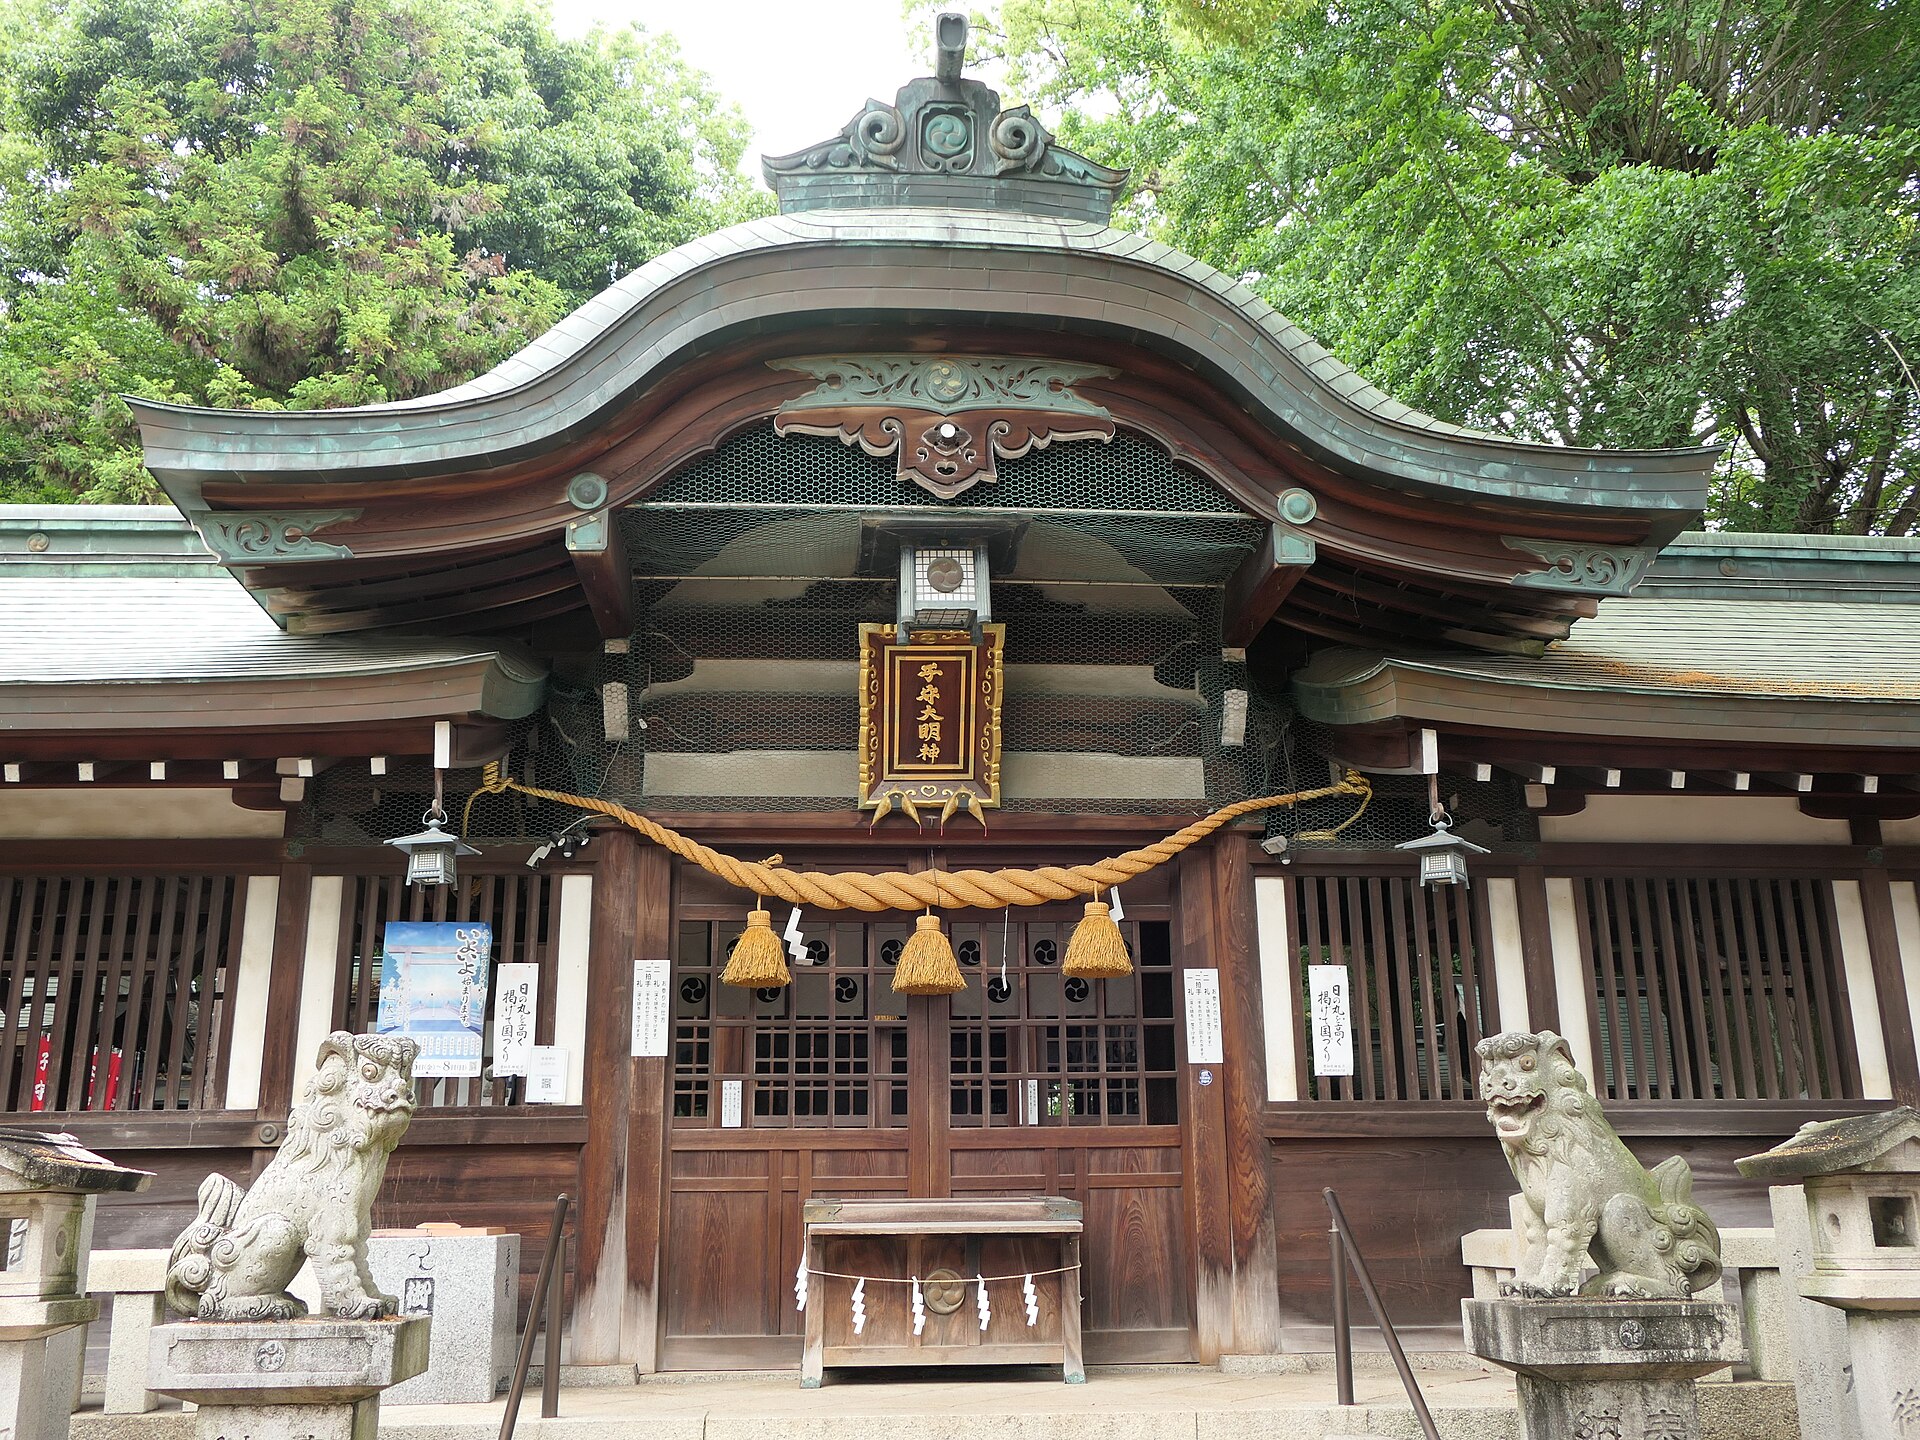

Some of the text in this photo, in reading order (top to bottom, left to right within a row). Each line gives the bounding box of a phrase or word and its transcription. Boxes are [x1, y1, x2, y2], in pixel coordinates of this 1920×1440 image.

[916, 662, 944, 765] 子守大明神
[516, 982, 531, 1047] 日の丸を高く
[1332, 984, 1345, 1047] 日の丸を高く
